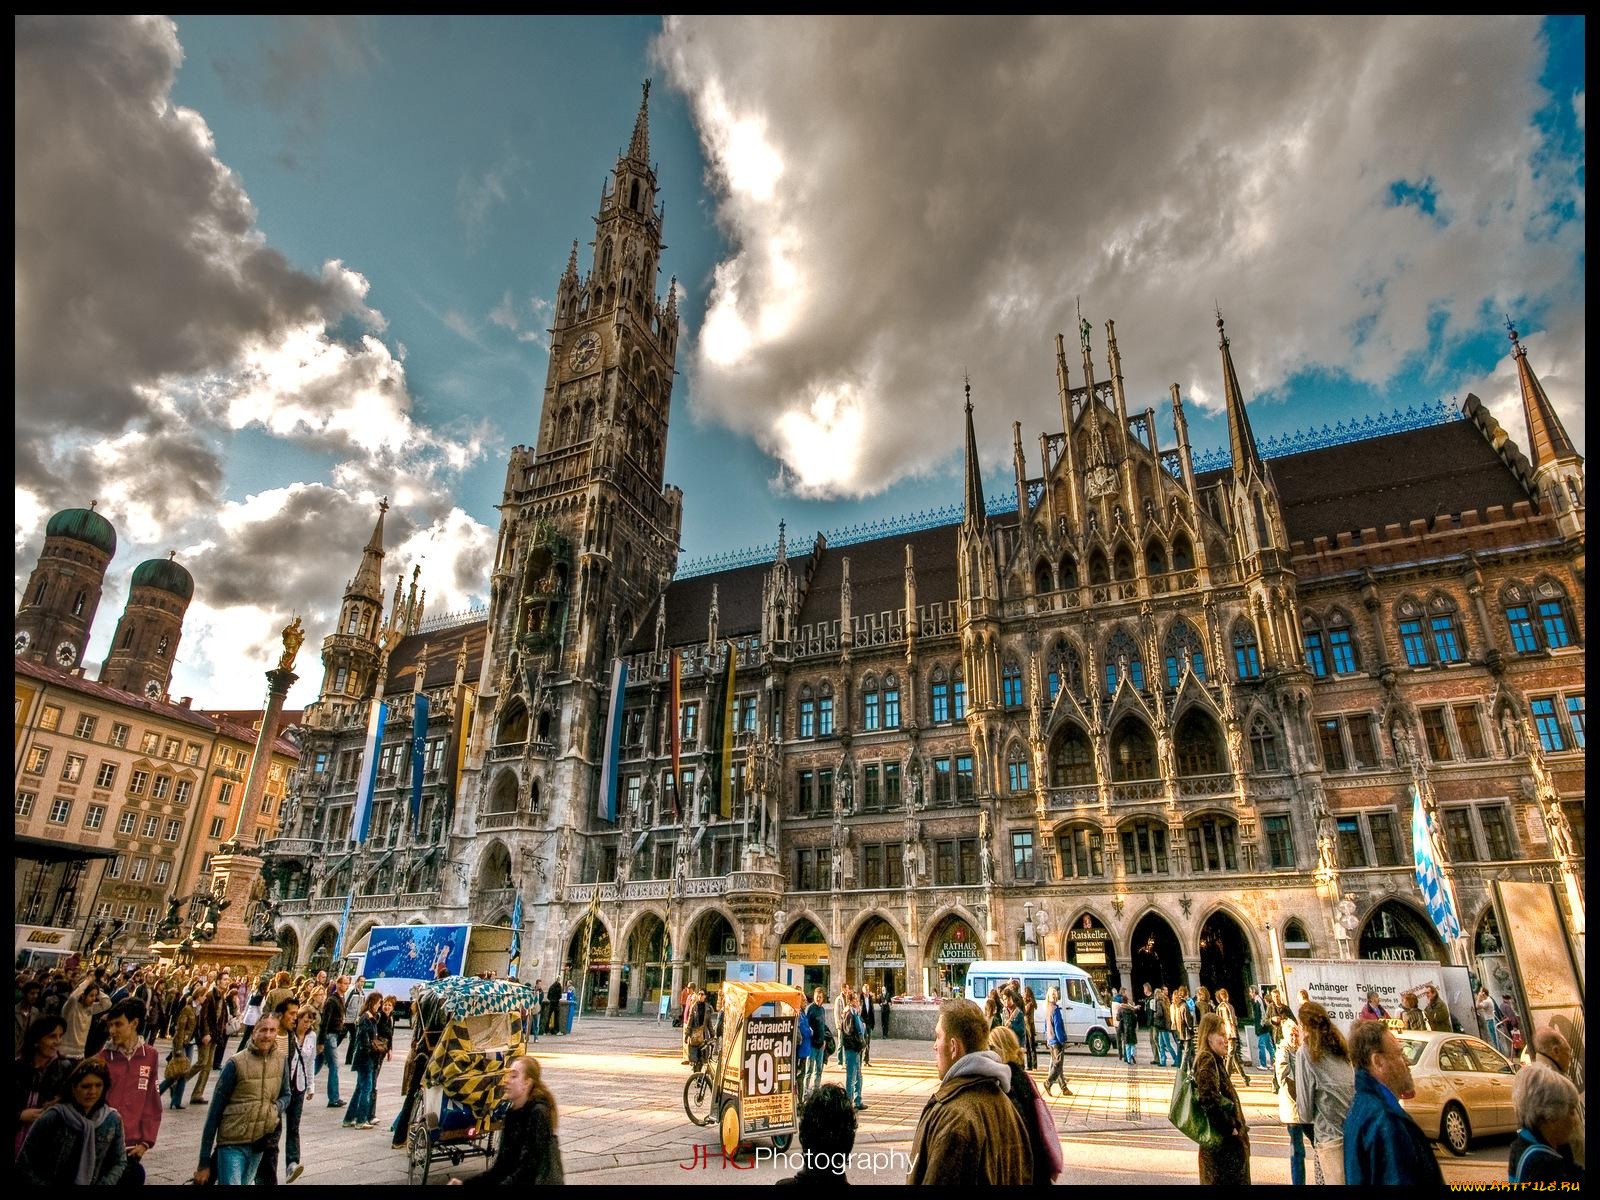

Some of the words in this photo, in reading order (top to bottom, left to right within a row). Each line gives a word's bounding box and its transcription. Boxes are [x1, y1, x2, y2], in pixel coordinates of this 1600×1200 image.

[1070, 930, 1108, 940] Ratskeller
[943, 942, 977, 950] RATHAUS
[940, 949, 981, 958] APOTHEKE
[1381, 948, 1416, 961] MAYER
[1308, 982, 1348, 994] Anhänger
[1356, 983, 1396, 996] Folkinger
[747, 1020, 794, 1034] Gebraucht-
[745, 1035, 775, 1051] räder
[774, 1036, 792, 1057] ab
[777, 1063, 791, 1073] EURO
